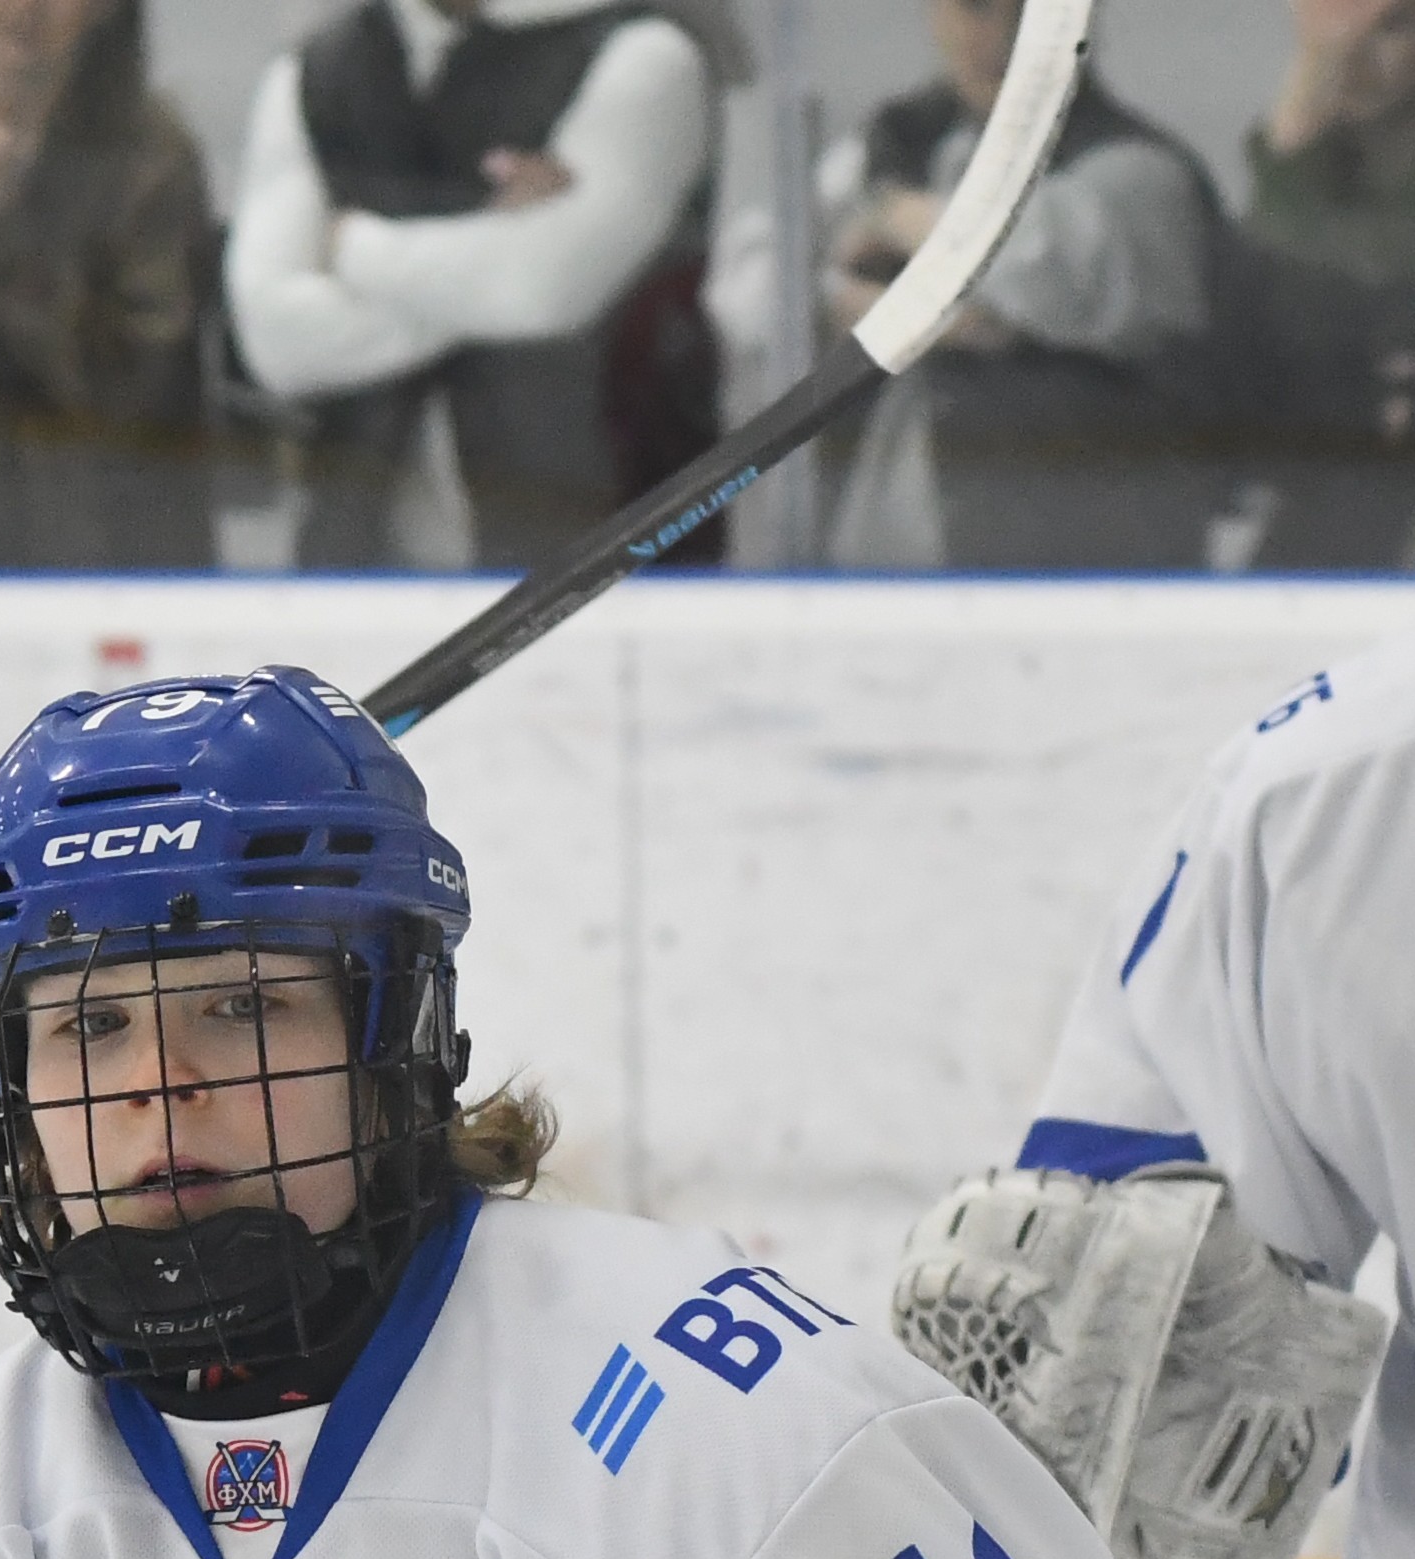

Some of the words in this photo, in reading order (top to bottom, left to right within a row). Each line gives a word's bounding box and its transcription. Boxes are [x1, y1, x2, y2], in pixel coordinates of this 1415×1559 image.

[41, 819, 202, 867] CCM
[427, 857, 469, 900] CCM
[653, 1266, 858, 1395] ВТ
[217, 1481, 279, 1506] ФХМ
